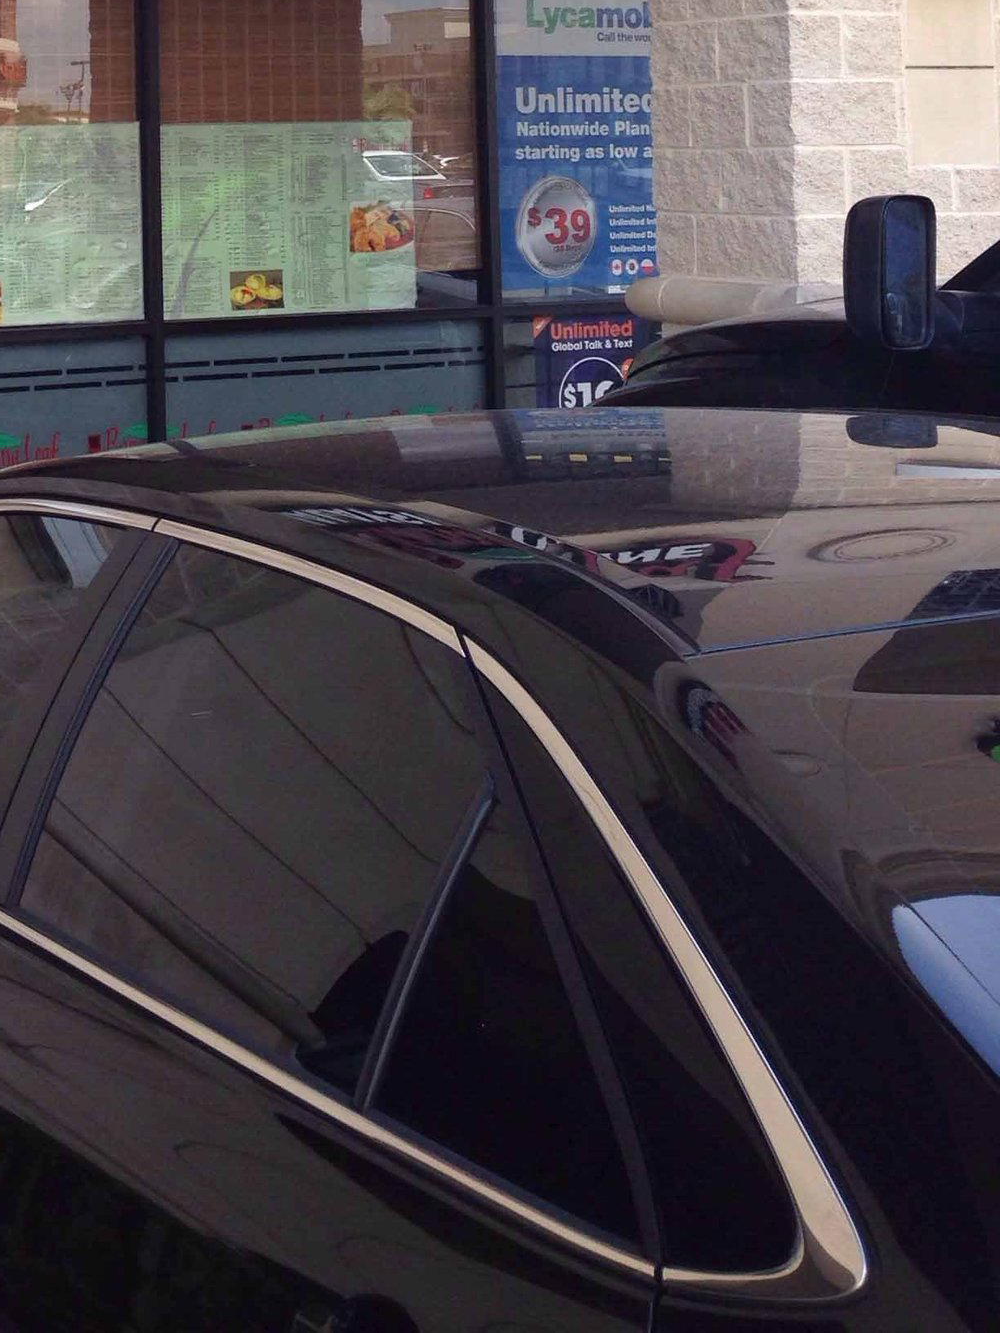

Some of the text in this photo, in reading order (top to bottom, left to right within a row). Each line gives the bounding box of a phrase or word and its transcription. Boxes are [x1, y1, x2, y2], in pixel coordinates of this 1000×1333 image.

[617, 32, 633, 42] the
[517, 121, 609, 137] Nationwide
[515, 144, 581, 162] starting
[585, 147, 605, 159] as
[610, 143, 638, 159] low
[527, 207, 592, 245] $39
[609, 218, 645, 226] Unlimited
[610, 231, 646, 239] Unlimited
[610, 245, 646, 253] Unlimited
[550, 319, 633, 340] Unlimited
[551, 339, 633, 352] Global Talk & Text
